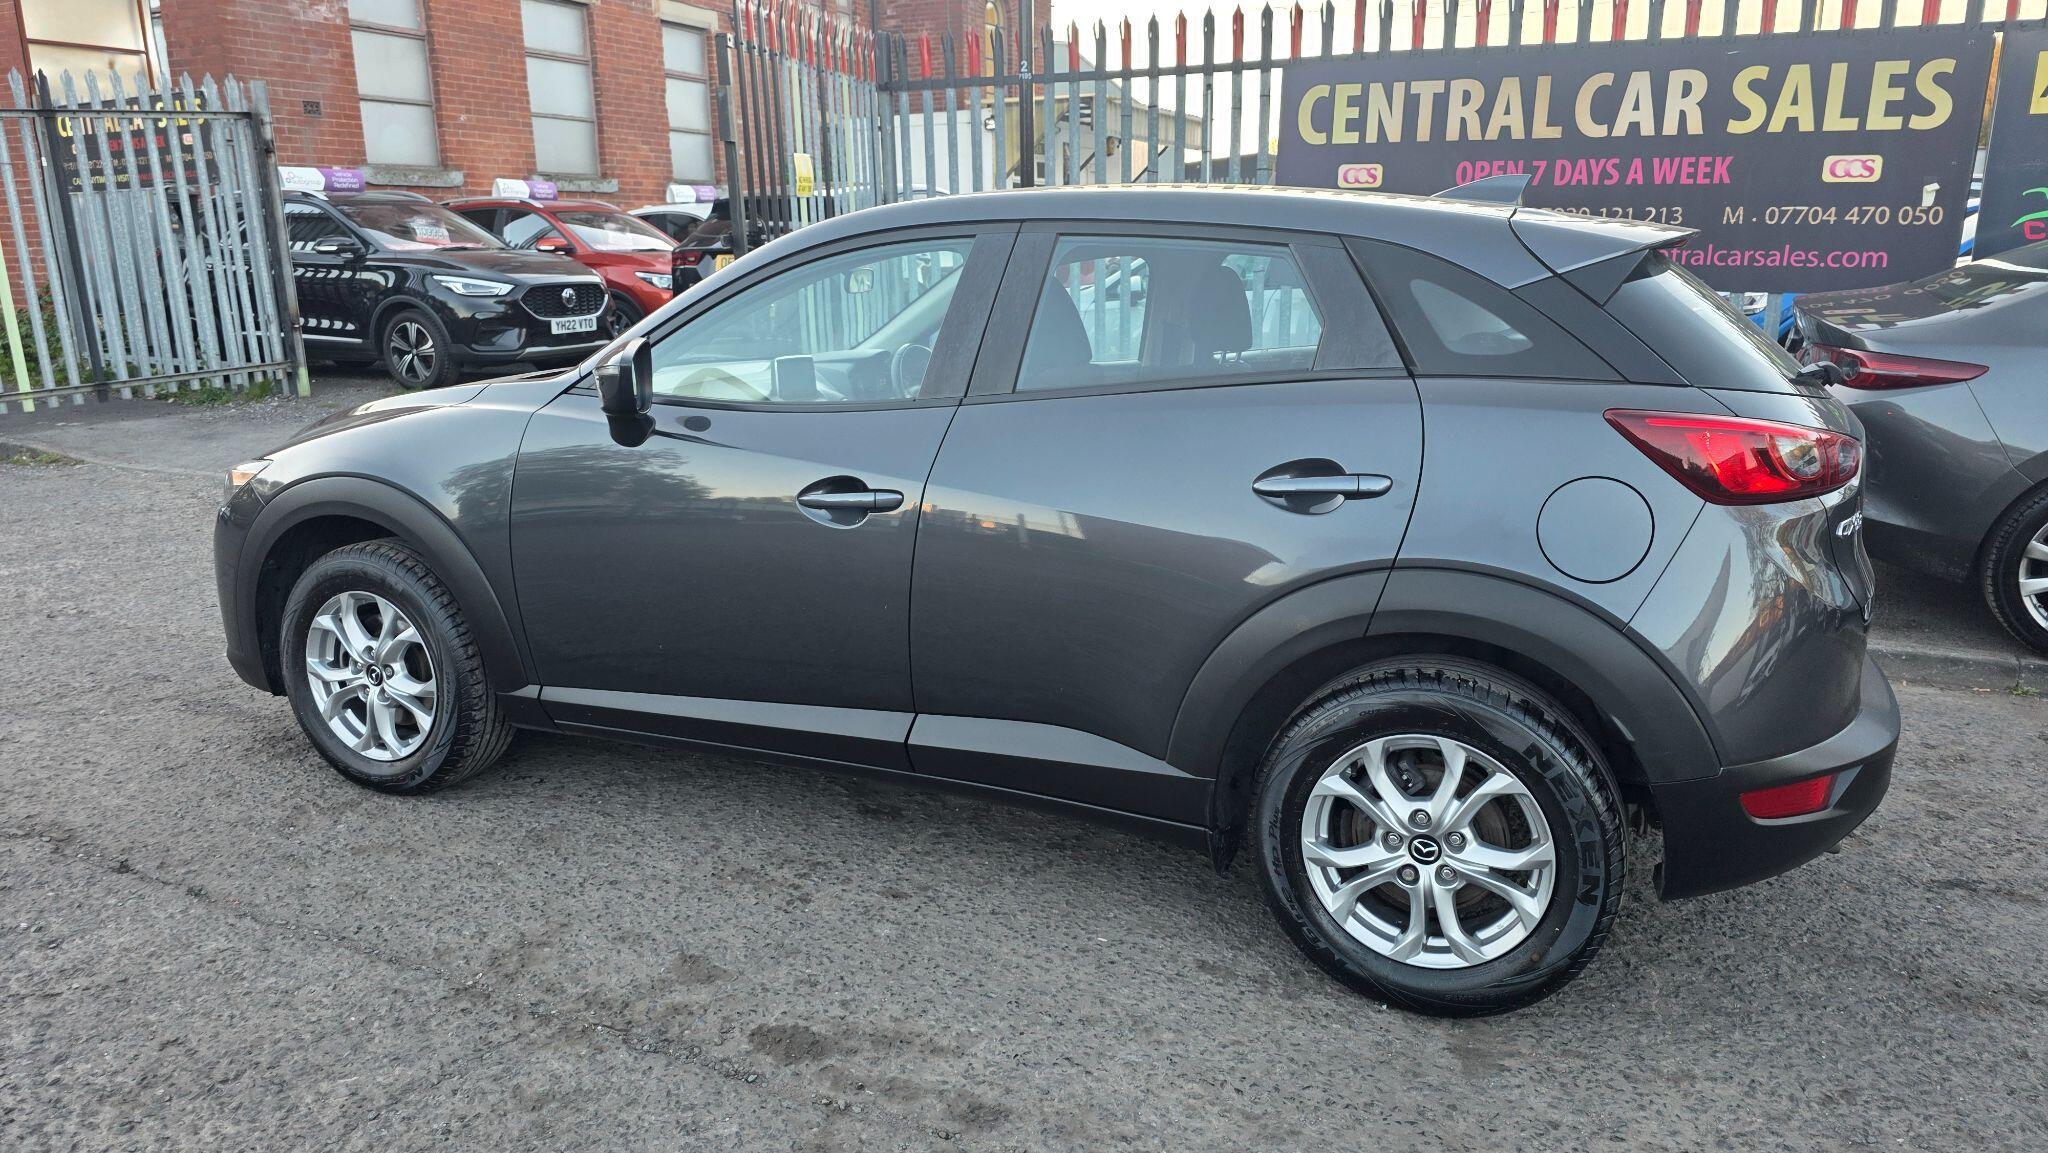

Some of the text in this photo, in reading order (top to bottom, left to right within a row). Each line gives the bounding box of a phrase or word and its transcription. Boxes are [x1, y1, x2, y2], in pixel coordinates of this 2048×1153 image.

[1020, 60, 1028, 72] 2
[1298, 58, 1957, 145] CENTRAL CAR SALES
[1532, 160, 1548, 186] 7
[1553, 158, 1620, 186] DAYS
[1625, 158, 1644, 185] A
[1652, 156, 1735, 185] WEEK
[1829, 158, 1875, 179] CCS
[1645, 206, 1683, 224] 213
[1722, 206, 1744, 225] M
[1765, 206, 1837, 225] 07704
[1844, 206, 1890, 225] 470
[1898, 206, 1944, 225] 050
[555, 318, 594, 331] YH22 VTO
[1268, 806, 1281, 841] Plus
[1521, 741, 1601, 906] NEXEN
